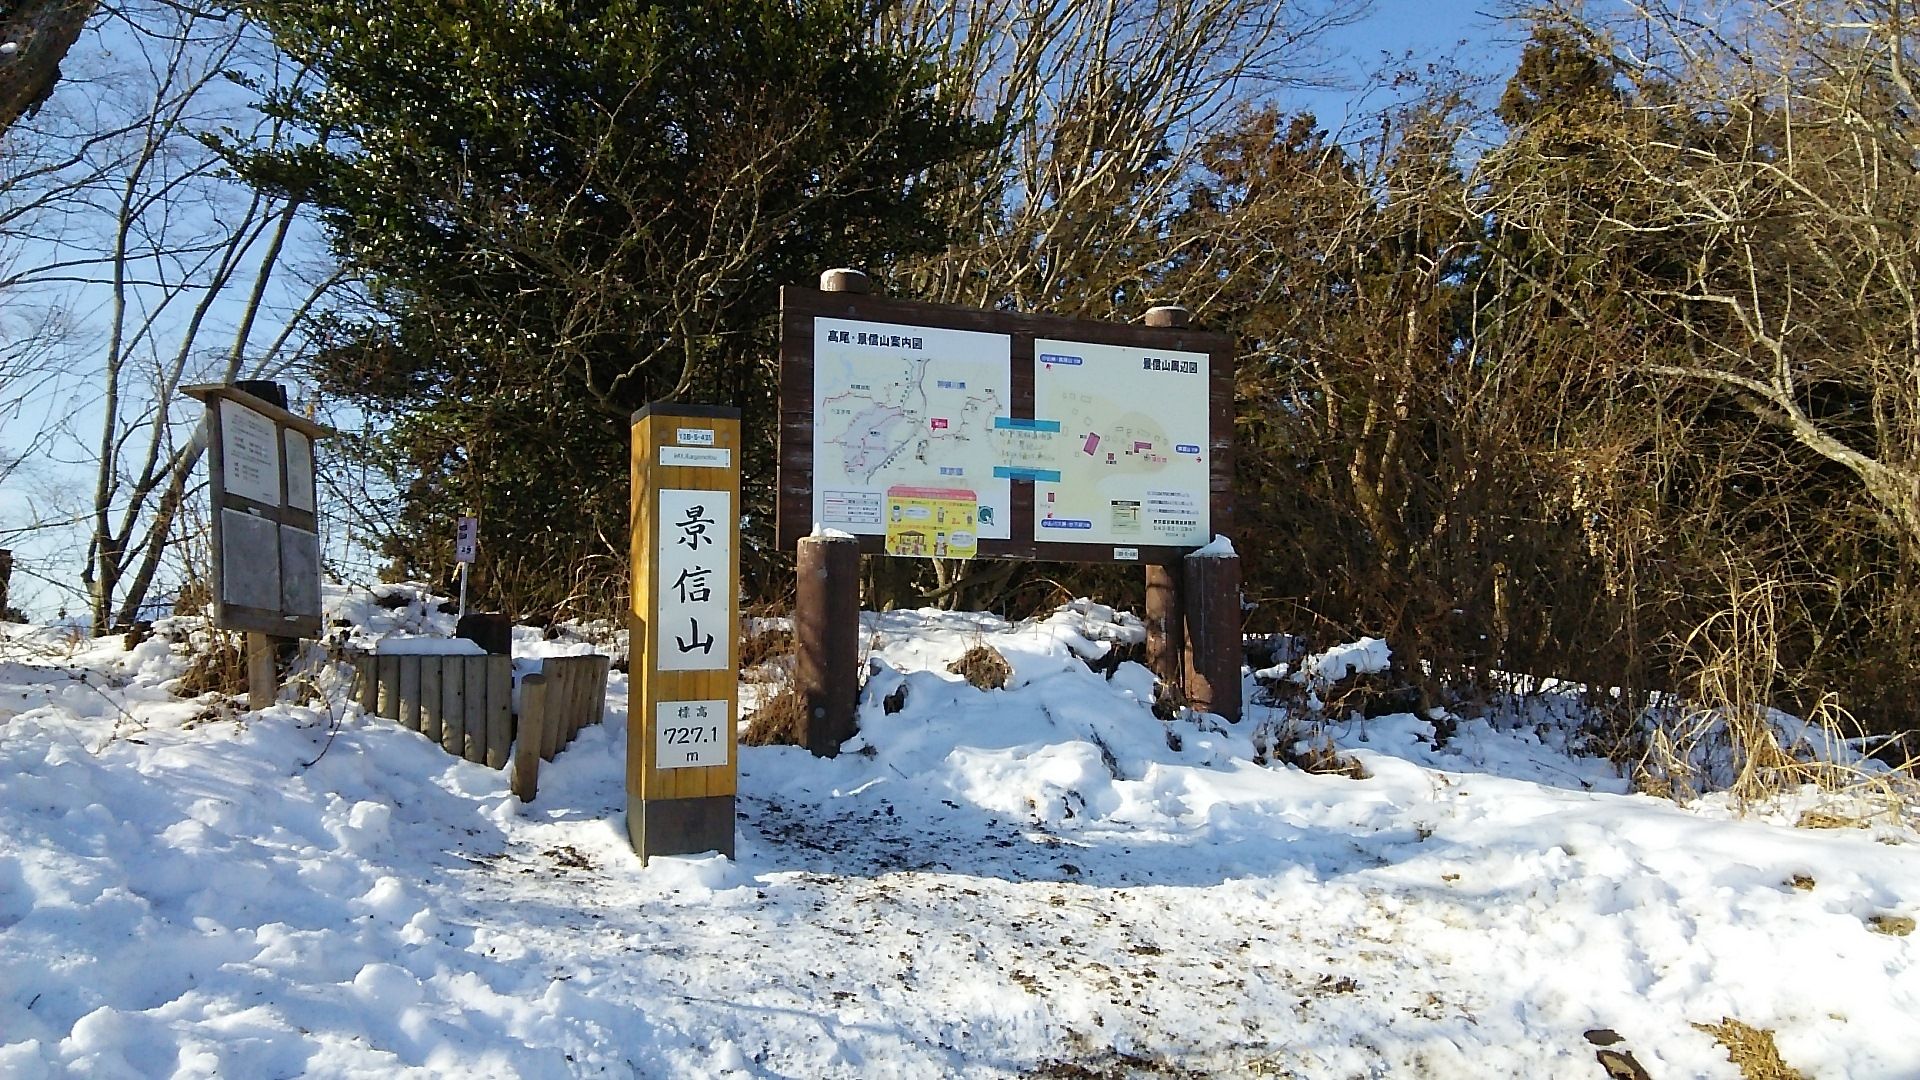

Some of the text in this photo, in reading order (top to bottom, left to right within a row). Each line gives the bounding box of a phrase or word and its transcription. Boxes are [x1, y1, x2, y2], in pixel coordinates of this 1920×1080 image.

[1143, 357, 1198, 374] 景信山周辺図
[672, 505, 715, 655] 景信山
[677, 705, 708, 719] 標高
[663, 726, 717, 744] 727.1
[686, 751, 699, 762] m
